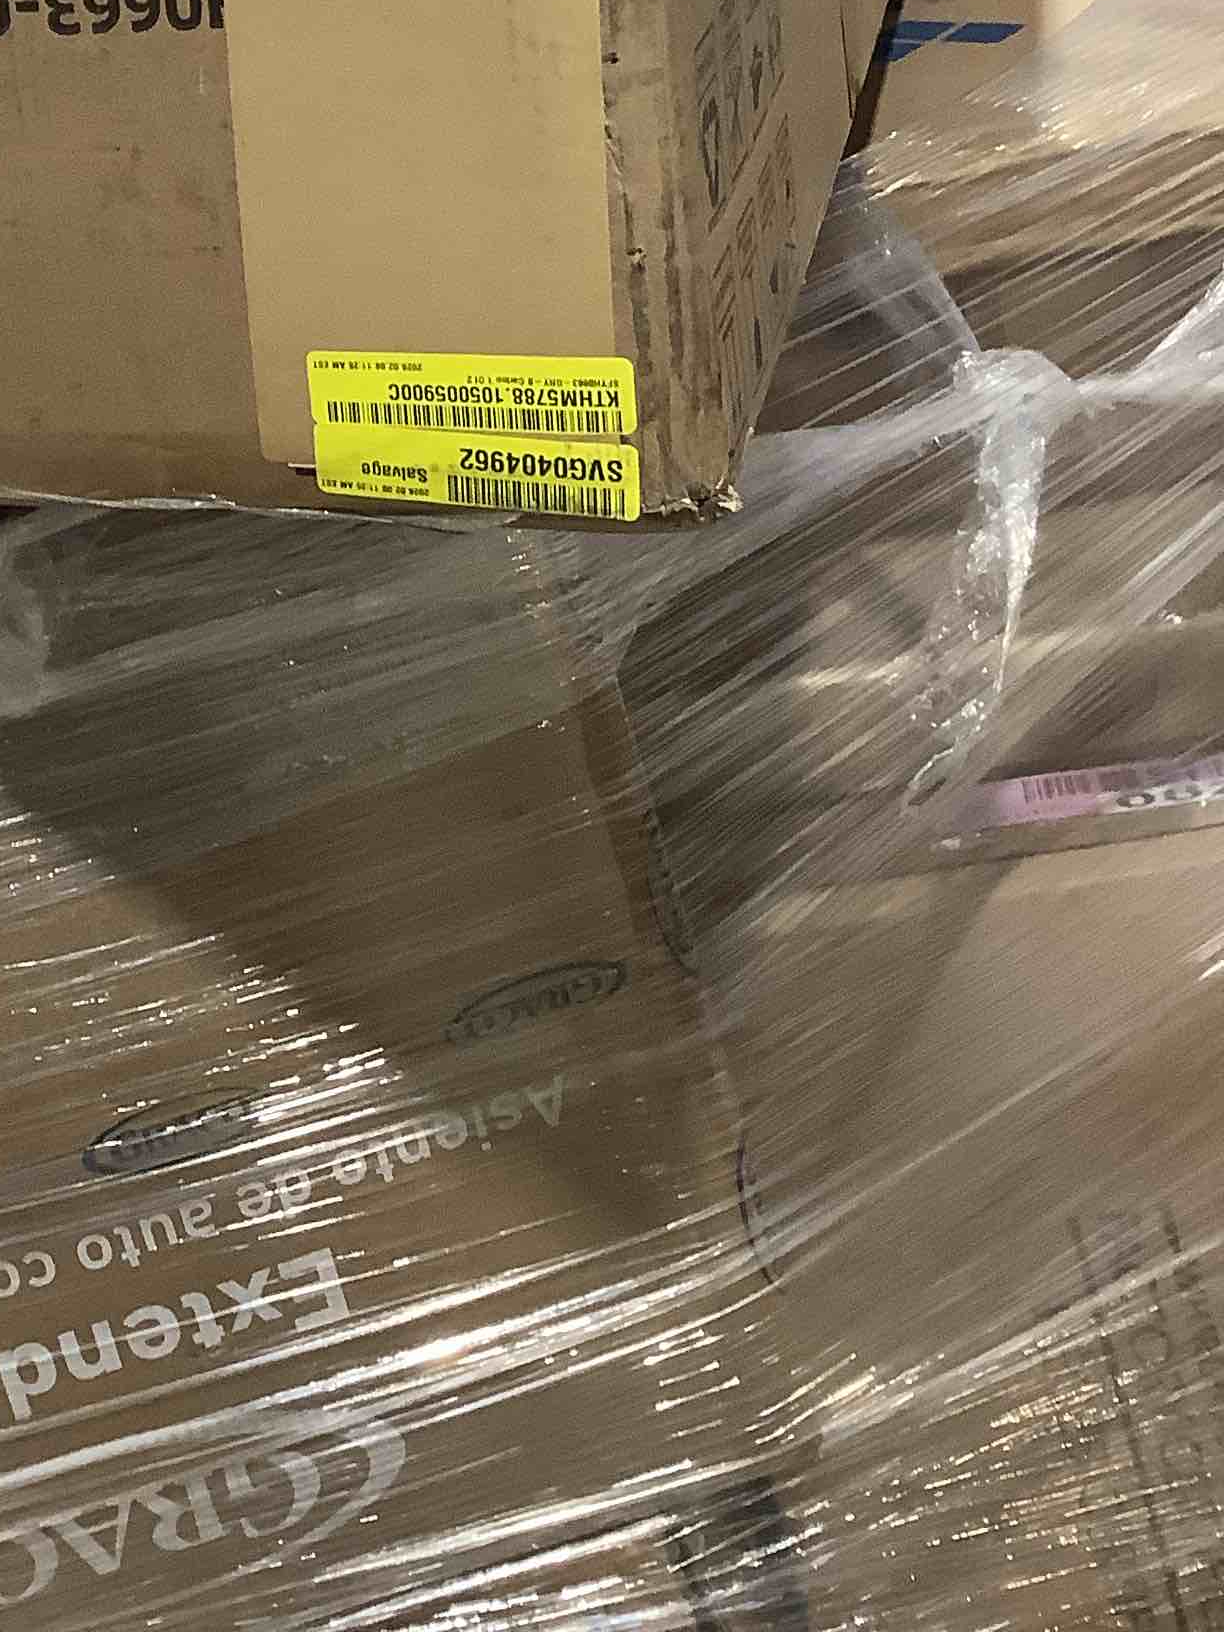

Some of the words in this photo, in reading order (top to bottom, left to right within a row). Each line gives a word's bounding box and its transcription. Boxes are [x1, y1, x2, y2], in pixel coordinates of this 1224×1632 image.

[361, 460, 429, 483] Salvage
[459, 447, 624, 483] SVG0404962
[333, 1075, 567, 1187] Asiento
[237, 1165, 314, 1222] de
[76, 1195, 218, 1271] auto
